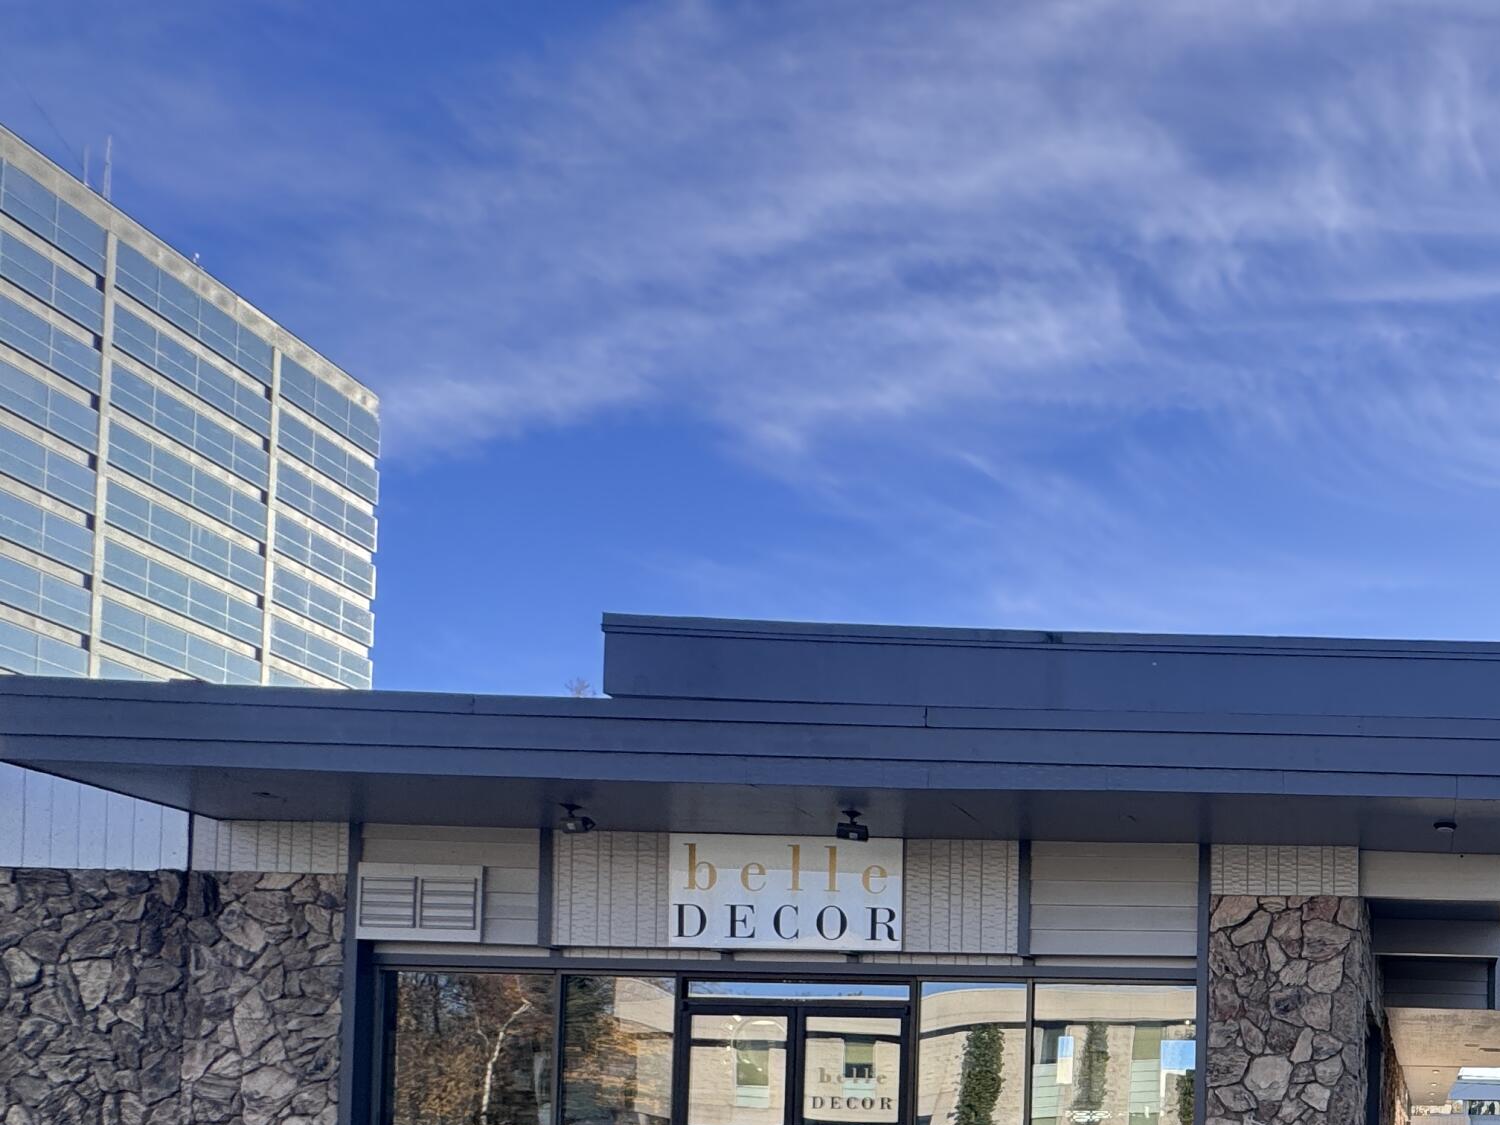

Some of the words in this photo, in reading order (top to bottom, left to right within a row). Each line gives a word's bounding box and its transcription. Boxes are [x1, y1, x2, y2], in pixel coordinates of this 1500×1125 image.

[683, 842, 888, 894] belle
[672, 903, 899, 942] DECOR
[818, 1067, 887, 1084] belle
[811, 1096, 892, 1110] DECOR
